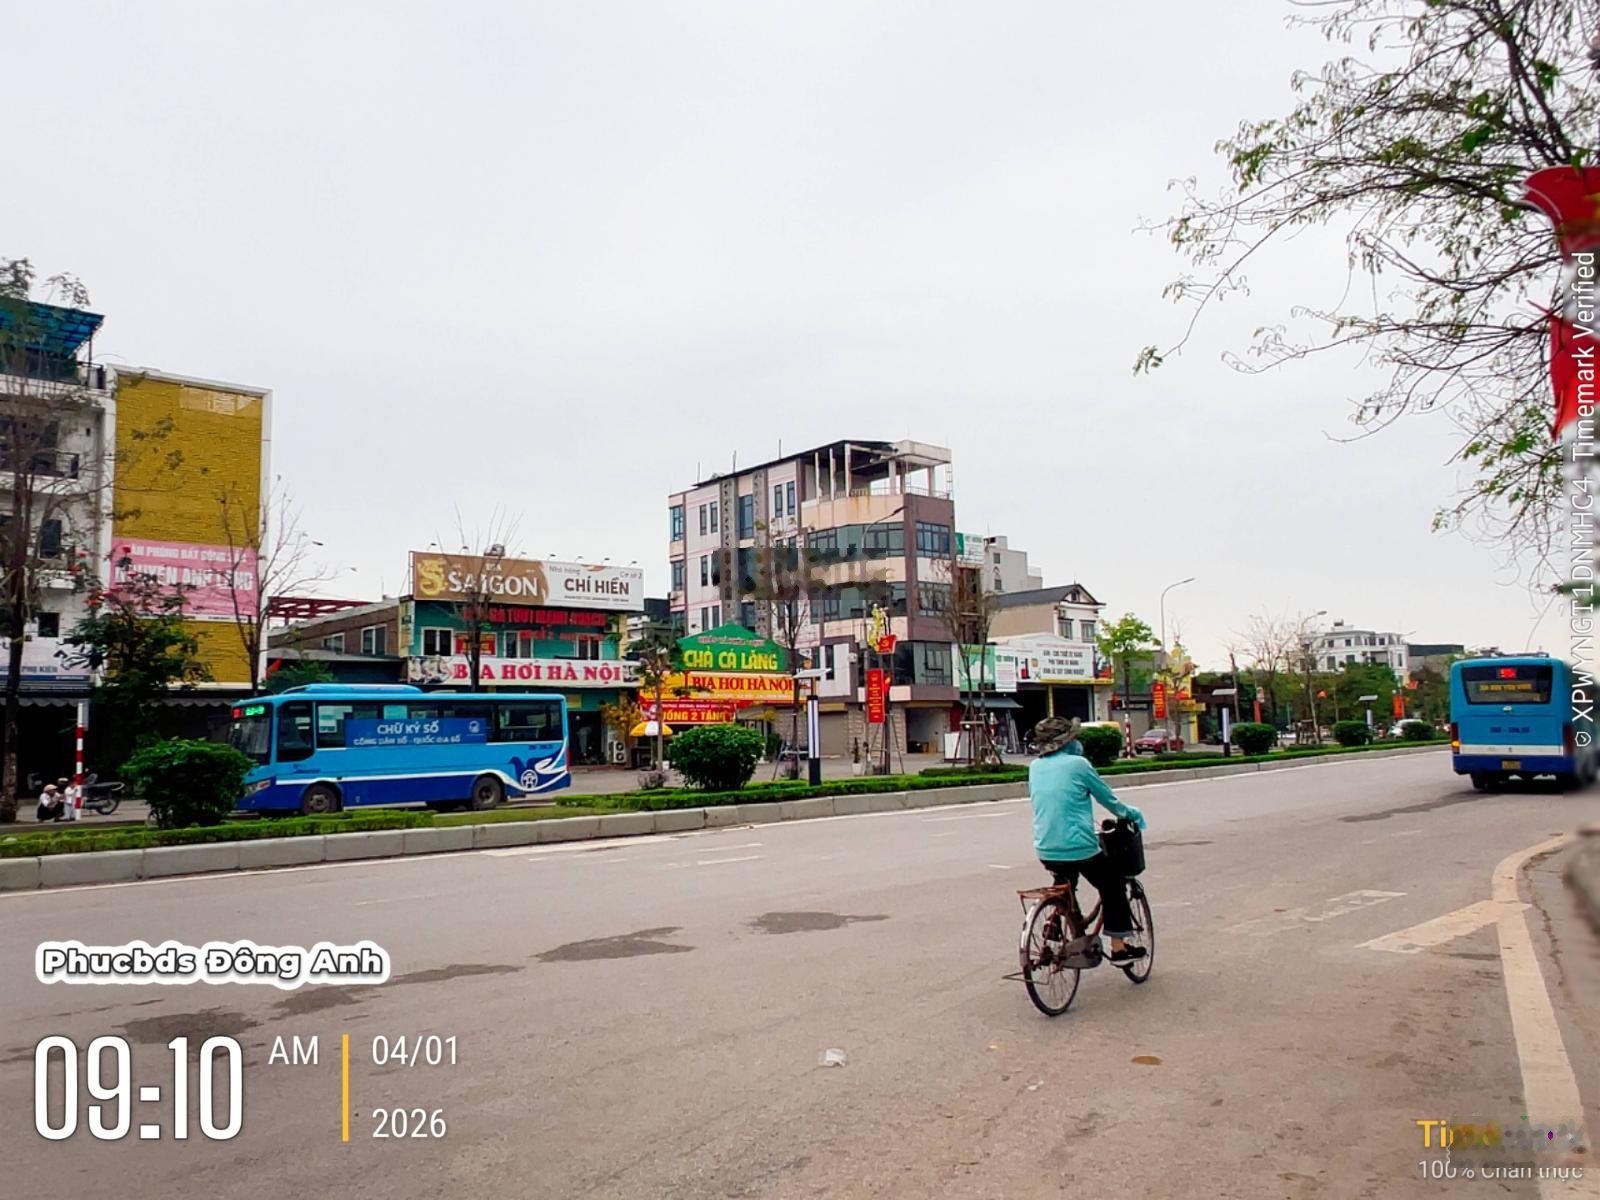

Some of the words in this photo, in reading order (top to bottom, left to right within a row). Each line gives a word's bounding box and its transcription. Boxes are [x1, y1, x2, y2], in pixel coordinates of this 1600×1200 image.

[564, 575, 591, 593] CHÍ
[684, 645, 713, 668] CHẢ
[718, 648, 737, 669] CÁ
[741, 649, 778, 670] LĂNG
[453, 663, 495, 680] BA
[501, 662, 542, 680] HƠI
[547, 661, 579, 681] HÀ
[583, 662, 621, 685] NỘI
[719, 676, 745, 691] HƠI
[747, 675, 766, 691] HÀ
[769, 676, 793, 694] NỘI
[690, 711, 698, 721] 2
[377, 721, 403, 735] CHỮ
[404, 720, 420, 734] KÝ
[422, 719, 440, 733] SỐ
